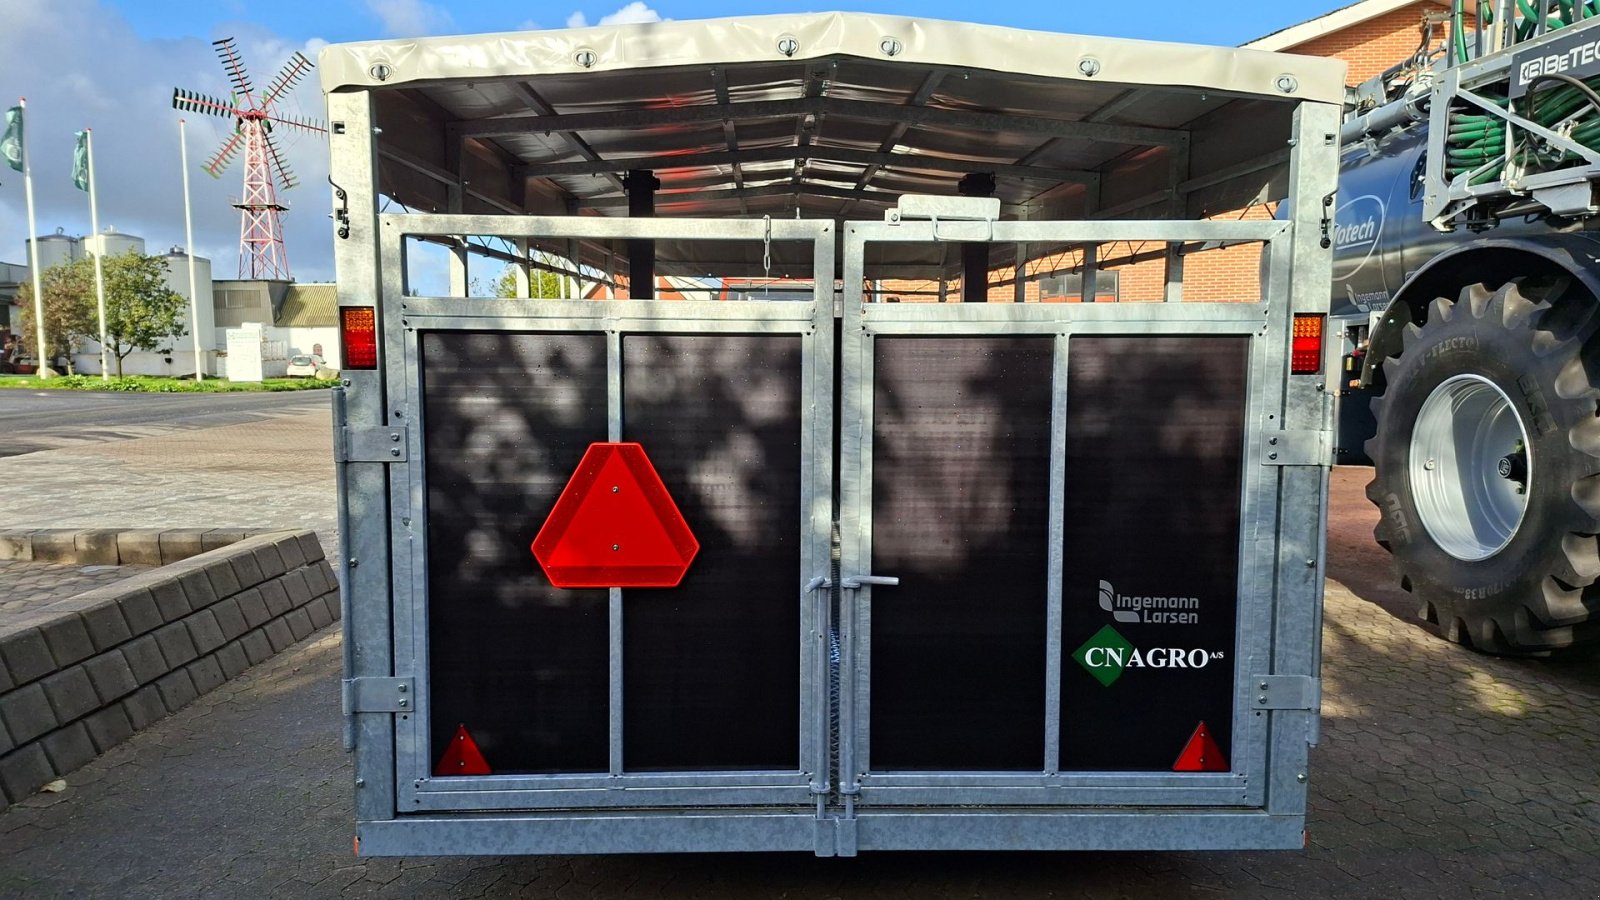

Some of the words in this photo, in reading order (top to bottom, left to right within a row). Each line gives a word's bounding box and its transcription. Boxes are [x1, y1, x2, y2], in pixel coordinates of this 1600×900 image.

[1116, 593, 1199, 611] Ingemann
[1143, 609, 1199, 624] Larsen
[1209, 651, 1225, 659] A/S
